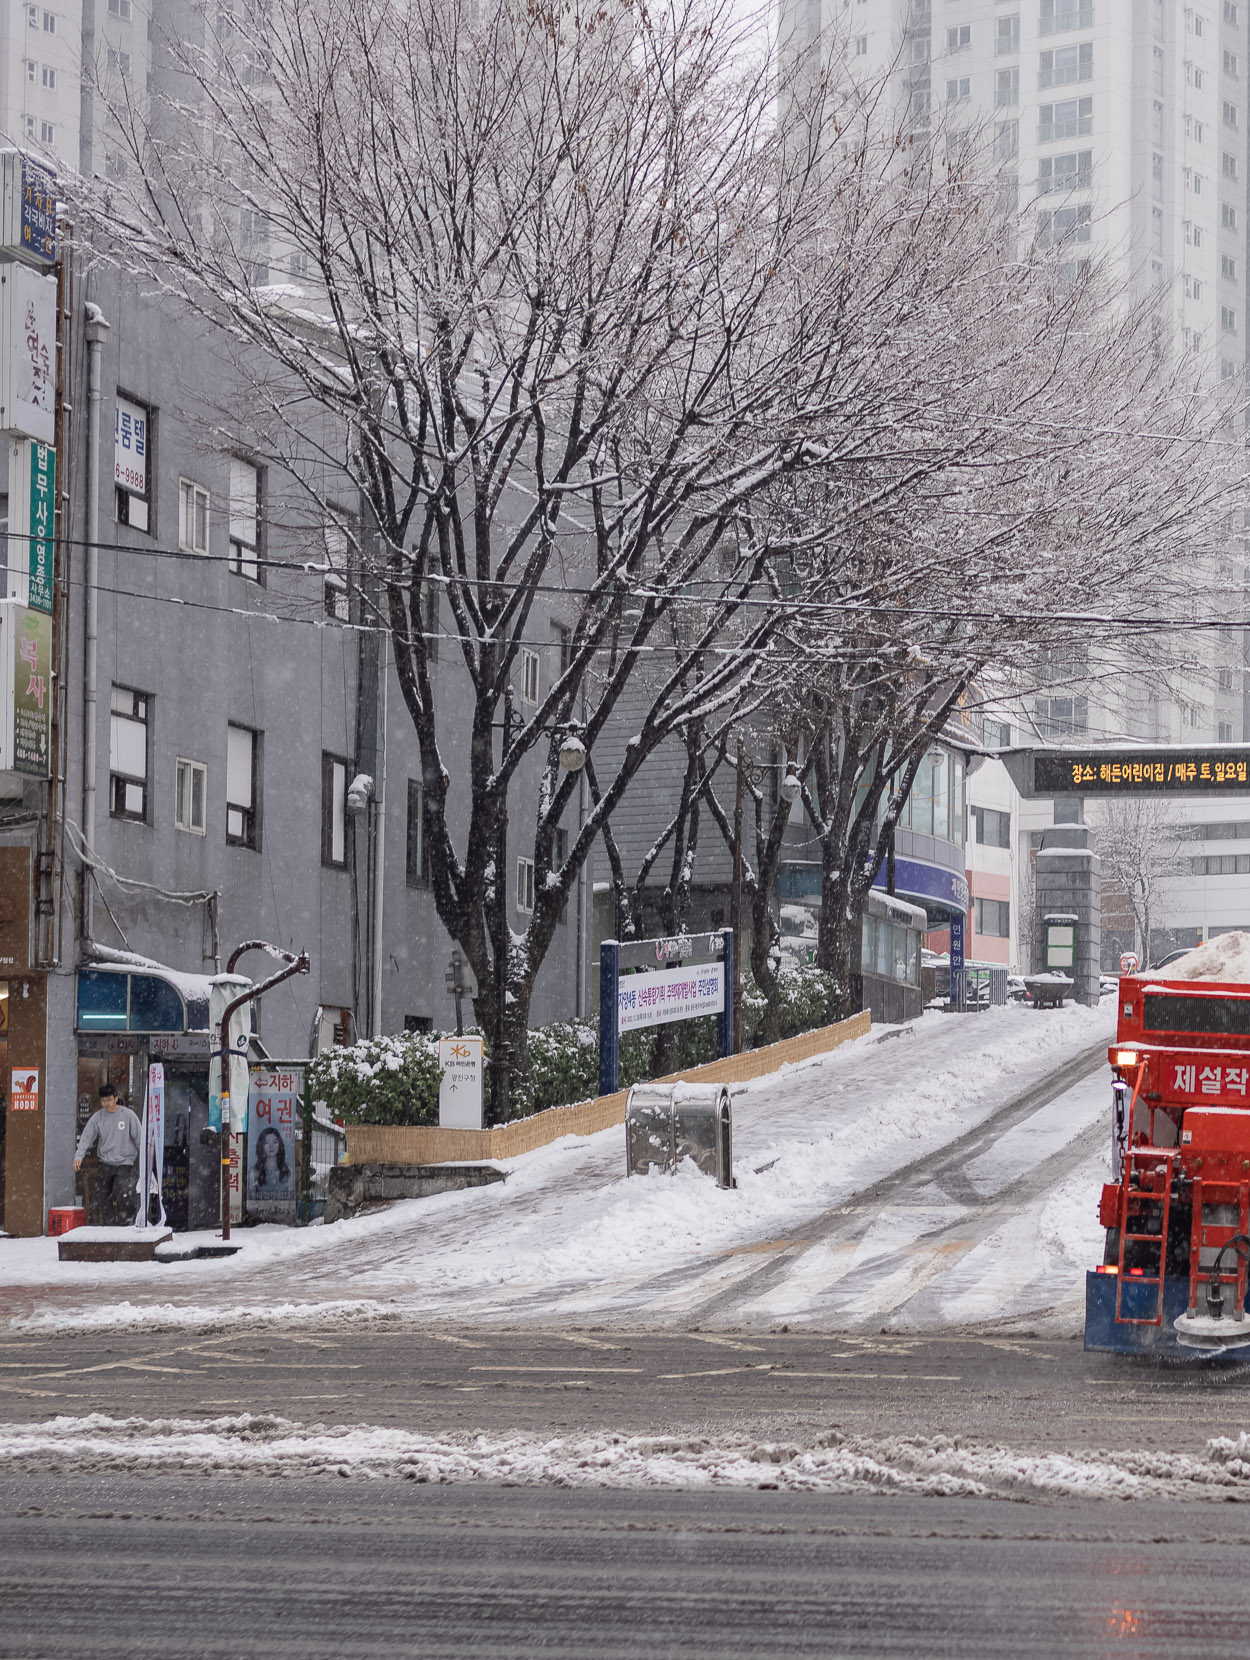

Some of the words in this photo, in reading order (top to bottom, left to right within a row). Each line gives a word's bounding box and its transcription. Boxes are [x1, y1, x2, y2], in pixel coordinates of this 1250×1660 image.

[115, 407, 145, 457] 룸텔
[19, 636, 47, 709] 복사
[1071, 763, 1098, 784] 장소:
[1100, 762, 1165, 783] 해든어린이집
[1175, 762, 1197, 782] 매주
[1199, 761, 1247, 782] 토,일요일
[268, 1073, 294, 1092] 지하
[451, 1073, 476, 1083] 광진구청
[255, 1097, 293, 1125] 여권
[118, 1120, 126, 1130] C
